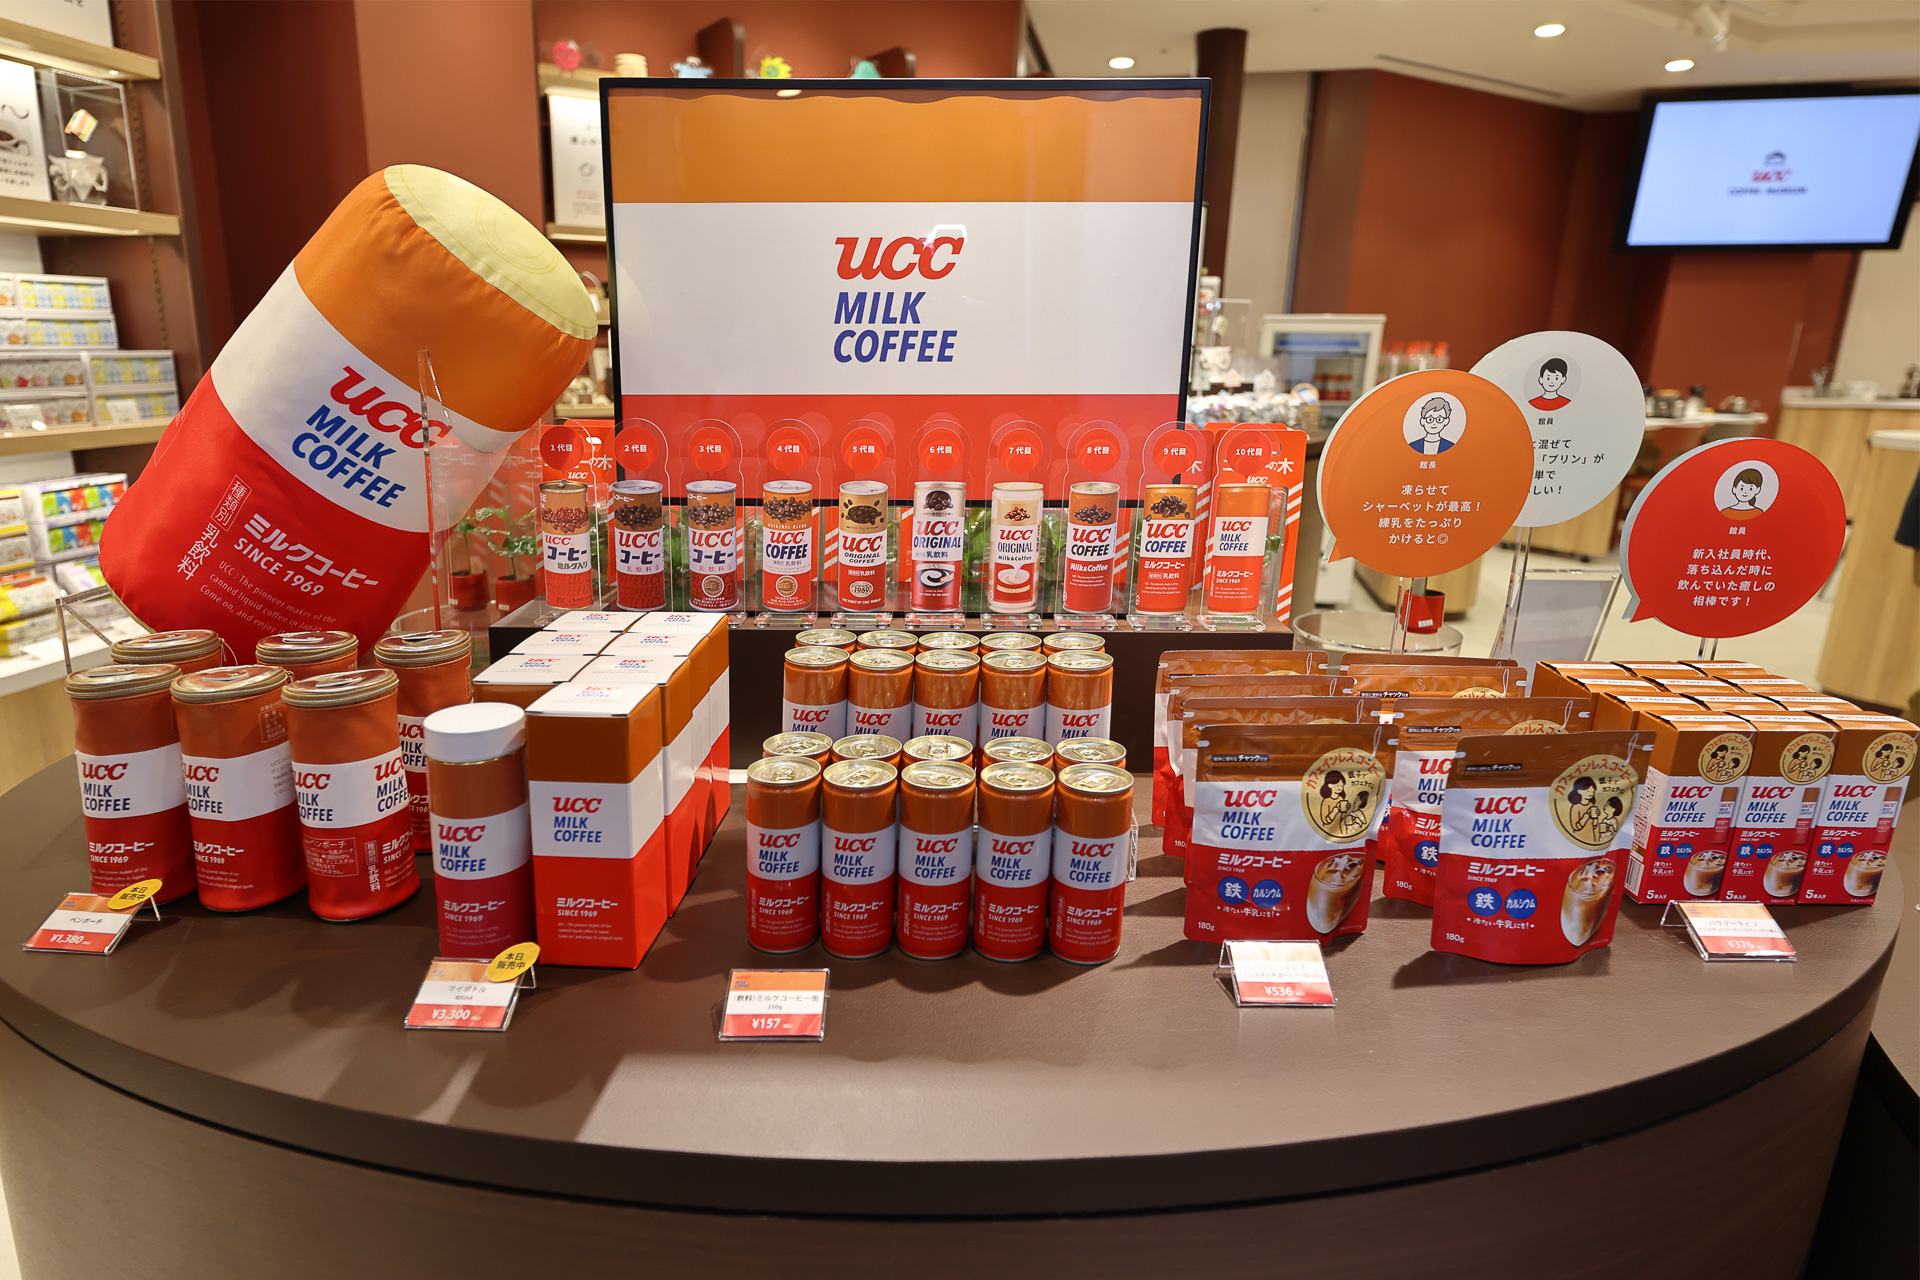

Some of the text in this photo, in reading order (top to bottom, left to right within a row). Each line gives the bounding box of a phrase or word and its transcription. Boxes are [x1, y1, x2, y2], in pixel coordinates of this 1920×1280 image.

[835, 236, 965, 280] UCC
[834, 291, 926, 324] MILK
[834, 330, 958, 363] COFFEE
[330, 365, 453, 449] UCC
[1538, 417, 1554, 425] 館員
[305, 404, 397, 469] MILK
[291, 432, 406, 508] COFFEE
[1419, 460, 1437, 469] 館長
[1401, 484, 1449, 496] 凍らせて
[214, 480, 249, 527] 種類別
[1363, 501, 1481, 512] シャーベットが最高！
[1378, 517, 1462, 529] 練乳をたっぷり
[1728, 526, 1746, 535] 館員
[618, 531, 660, 549] UCC
[691, 530, 734, 548] UCC
[914, 536, 961, 548] ORIGINAL
[177, 522, 221, 581] 乳飲料
[243, 513, 379, 590] ミルクコーヒー
[547, 546, 587, 560] コーヒー
[766, 544, 808, 560] COFFEE
[998, 542, 1033, 553] ORIGINAL
[1071, 544, 1110, 556] COFFEE
[1145, 541, 1187, 553] COFFEE
[1219, 543, 1249, 551] COFFEE
[620, 549, 661, 565] コーヒー
[692, 548, 734, 564] コーヒー
[233, 537, 324, 596] SINCE 1969
[1070, 563, 1108, 572] Milk&Coffee
[1144, 561, 1185, 569] ミルクコーヒー
[1686, 564, 1773, 576] 落ち込んだ時に
[1677, 579, 1776, 591] 飲んでいた癒しの
[209, 572, 239, 596] canned
[237, 591, 264, 611] liquid
[262, 607, 288, 624] coffee
[238, 575, 254, 590] The
[252, 586, 285, 608] pioneer
[286, 603, 311, 618] maker
[200, 583, 222, 603] Come
[236, 608, 254, 622] and
[253, 618, 277, 635] enjoy
[792, 708, 830, 726] UCC
[991, 711, 1029, 727] UCC
[81, 762, 128, 781] UCC
[1305, 751, 1380, 790] カフェインレスコーヒー
[1553, 758, 1633, 795] カフェインレスコーヒー
[83, 782, 112, 798] MILK
[1671, 786, 1713, 798] UCC
[1751, 786, 1795, 799] UCC
[1834, 785, 1877, 798] UCC
[84, 798, 131, 812] COFFEE
[552, 796, 602, 814] UCC
[1223, 790, 1277, 807] UCC
[1829, 800, 1861, 810] MILK
[1474, 796, 1527, 815] UCC
[1666, 801, 1698, 811] MILK
[1747, 802, 1779, 812] MILK
[553, 816, 588, 830] MILK
[1221, 811, 1262, 825] MILK
[1664, 812, 1706, 823] COFFEE
[1745, 813, 1787, 823] COFFEE
[1826, 811, 1869, 822] COFFEE
[1472, 818, 1513, 833] MILK
[437, 823, 485, 843] UCC
[553, 830, 602, 843] COFFEE
[1220, 825, 1275, 841] COFFEE
[758, 832, 801, 848] UCC
[834, 836, 876, 852] UCC
[916, 837, 958, 853] UCC
[991, 838, 1035, 855] UCC
[1470, 834, 1527, 849] COFFEE
[89, 842, 154, 854] ミルクコーヒー
[439, 843, 470, 858] MILK
[1071, 841, 1115, 857] UCC
[1421, 846, 1438, 862] 鉄
[109, 855, 129, 864] 1969
[758, 849, 788, 862] MILK
[833, 853, 864, 866] MILK
[915, 854, 946, 868] MILK
[991, 855, 1021, 869] MILK
[1217, 853, 1292, 868] ミルクコーヒー
[440, 857, 486, 872] COFFEE
[758, 861, 800, 873] COFFEE
[1070, 858, 1102, 871] MILK
[1467, 862, 1546, 877] ミルクコーヒー
[833, 865, 875, 878] COFFEE
[914, 866, 956, 879] COFFEE
[990, 867, 1032, 881] COFFEE
[1069, 870, 1112, 884] COFFEE
[1224, 882, 1242, 899] 鉄
[1396, 880, 1413, 891] 180g
[1252, 887, 1282, 899] カルシウム
[443, 899, 506, 913] ミルクコーヒー
[556, 897, 618, 909] ミルクコーヒー
[758, 896, 809, 907] ミルクコーヒー
[833, 901, 884, 912] ミルクコーヒー
[913, 901, 964, 913] ミルクコーヒー
[1475, 893, 1494, 909] 鉄
[1506, 898, 1536, 909] カルシウム
[557, 909, 578, 917] SINCE
[758, 907, 793, 916] SINCE 1969
[988, 903, 1039, 915] ミルクコーヒー
[1066, 906, 1118, 918] ミルクコーヒー
[444, 913, 483, 923] SINCE 1969
[1066, 916, 1102, 926] SINCE 1969
[1197, 921, 1215, 931] 180g
[49, 933, 85, 945] ¥1,380
[1446, 932, 1465, 943] 180g
[1726, 940, 1755, 949] ¥376
[505, 952, 525, 961] 本日
[496, 961, 526, 970] 販売中
[449, 985, 487, 993] マイボトル
[1264, 986, 1293, 996] ¥536
[431, 1009, 471, 1020] ¥3,300
[752, 1018, 781, 1029] ¥157
